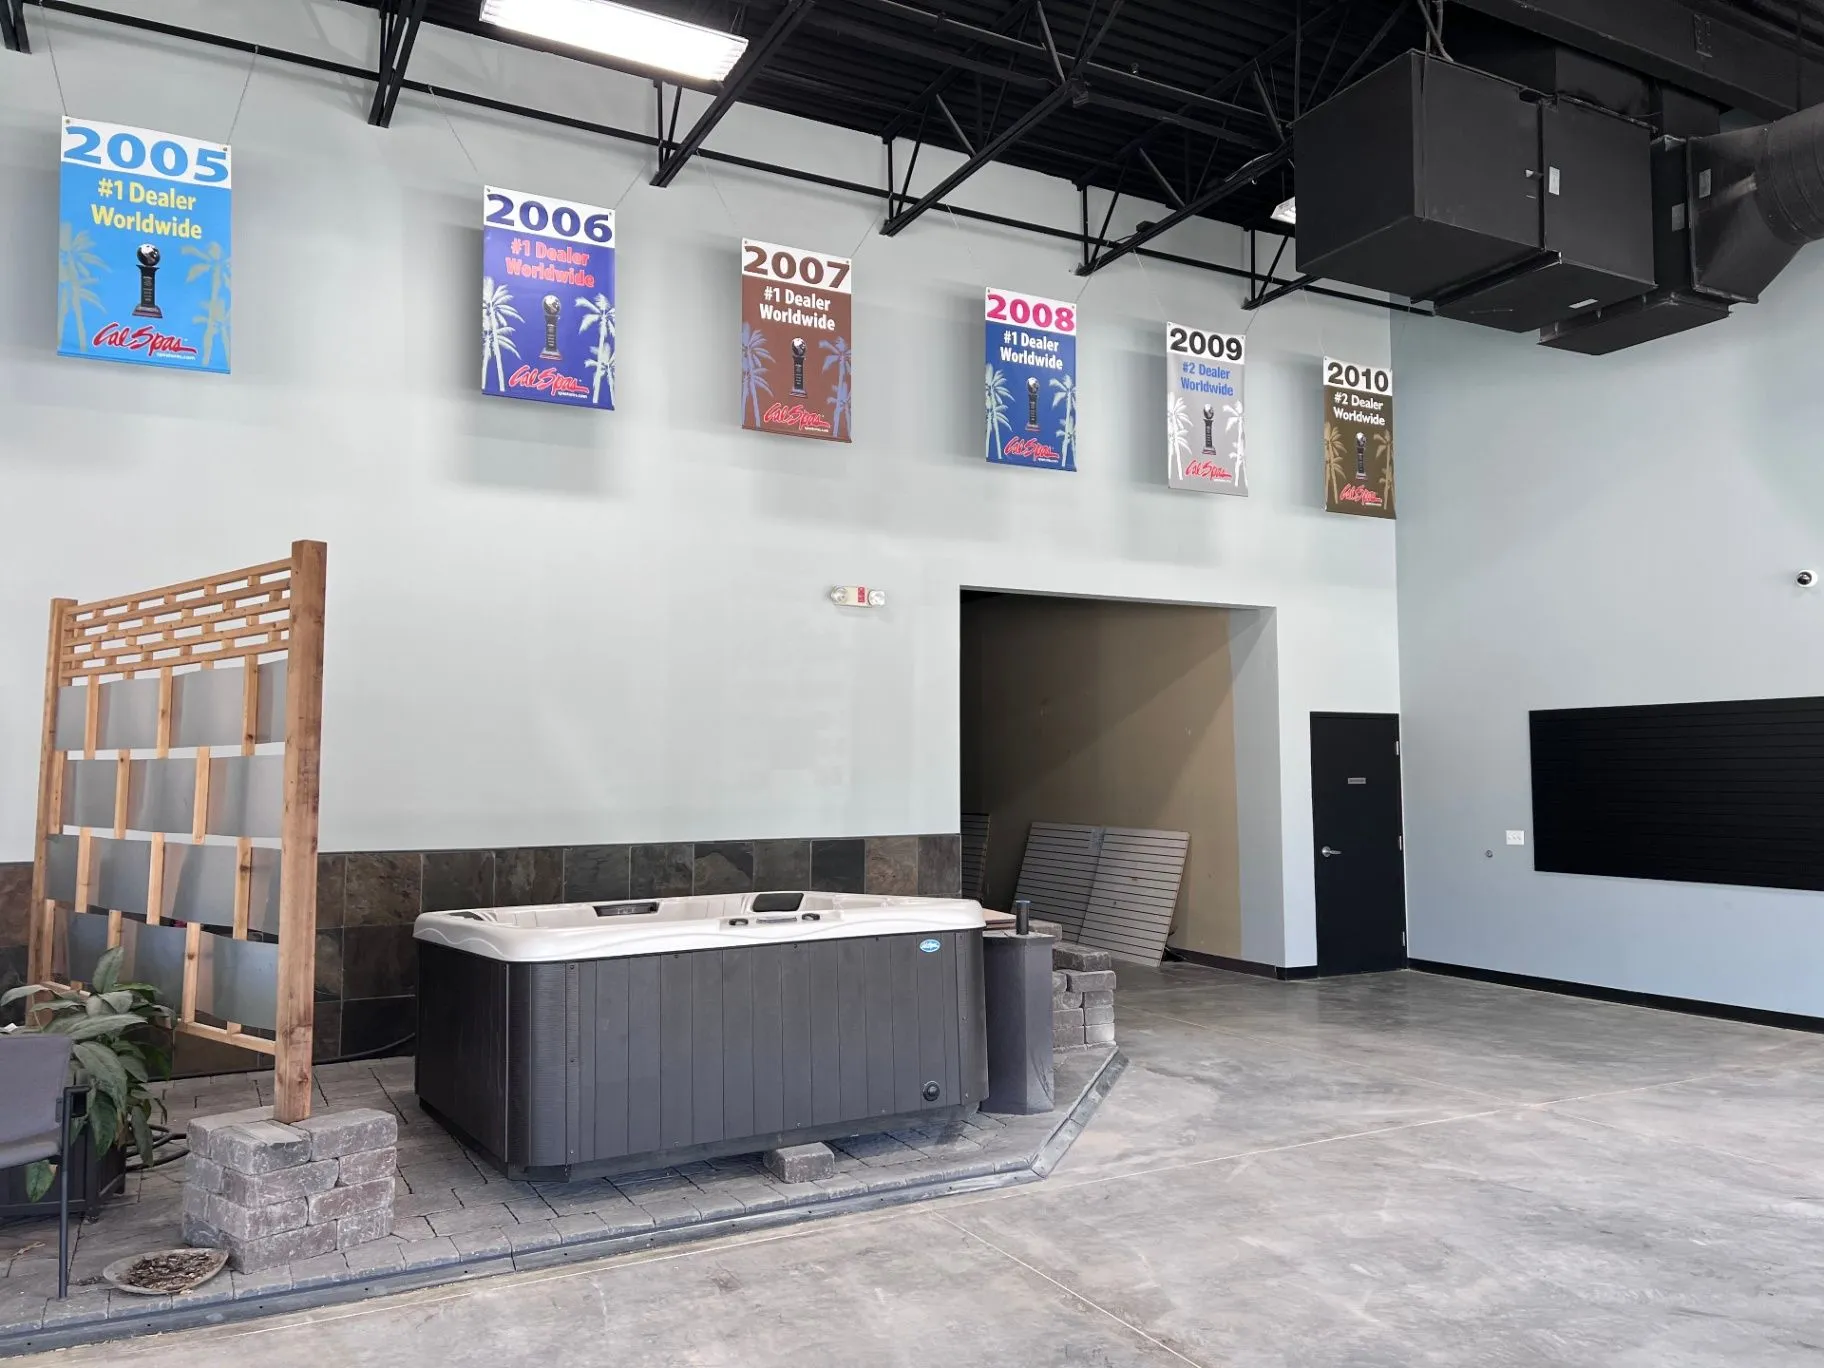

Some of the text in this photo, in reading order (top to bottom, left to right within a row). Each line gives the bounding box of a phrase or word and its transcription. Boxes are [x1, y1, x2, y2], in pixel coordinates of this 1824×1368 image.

[64, 126, 228, 182] 2005
[98, 178, 197, 211] #1 Dealer
[91, 204, 202, 239] Worldwide
[486, 193, 613, 243] 2006
[511, 238, 590, 266] #1 Dealer
[505, 257, 595, 288] Worldwide
[744, 245, 850, 289] 2007
[764, 286, 831, 311] #1 Dealer
[760, 303, 835, 331] Worldwide
[987, 294, 1074, 332] 2008
[92, 322, 197, 356] Cal Spas
[1004, 330, 1059, 352] #1 Dealer
[1170, 328, 1242, 361] 2009
[1000, 347, 1063, 370] Worldwide
[1183, 362, 1230, 379] #2 Dealer
[508, 365, 589, 395] Cal Spas
[1181, 377, 1233, 396] Worldwide
[1328, 362, 1388, 392] 2010
[1334, 392, 1383, 410] #2 Dealer
[764, 403, 830, 430] Cal Spas
[1333, 407, 1385, 425] Worldwide
[1004, 436, 1059, 461] Cal Spas
[1185, 460, 1232, 480] Cal Spas
